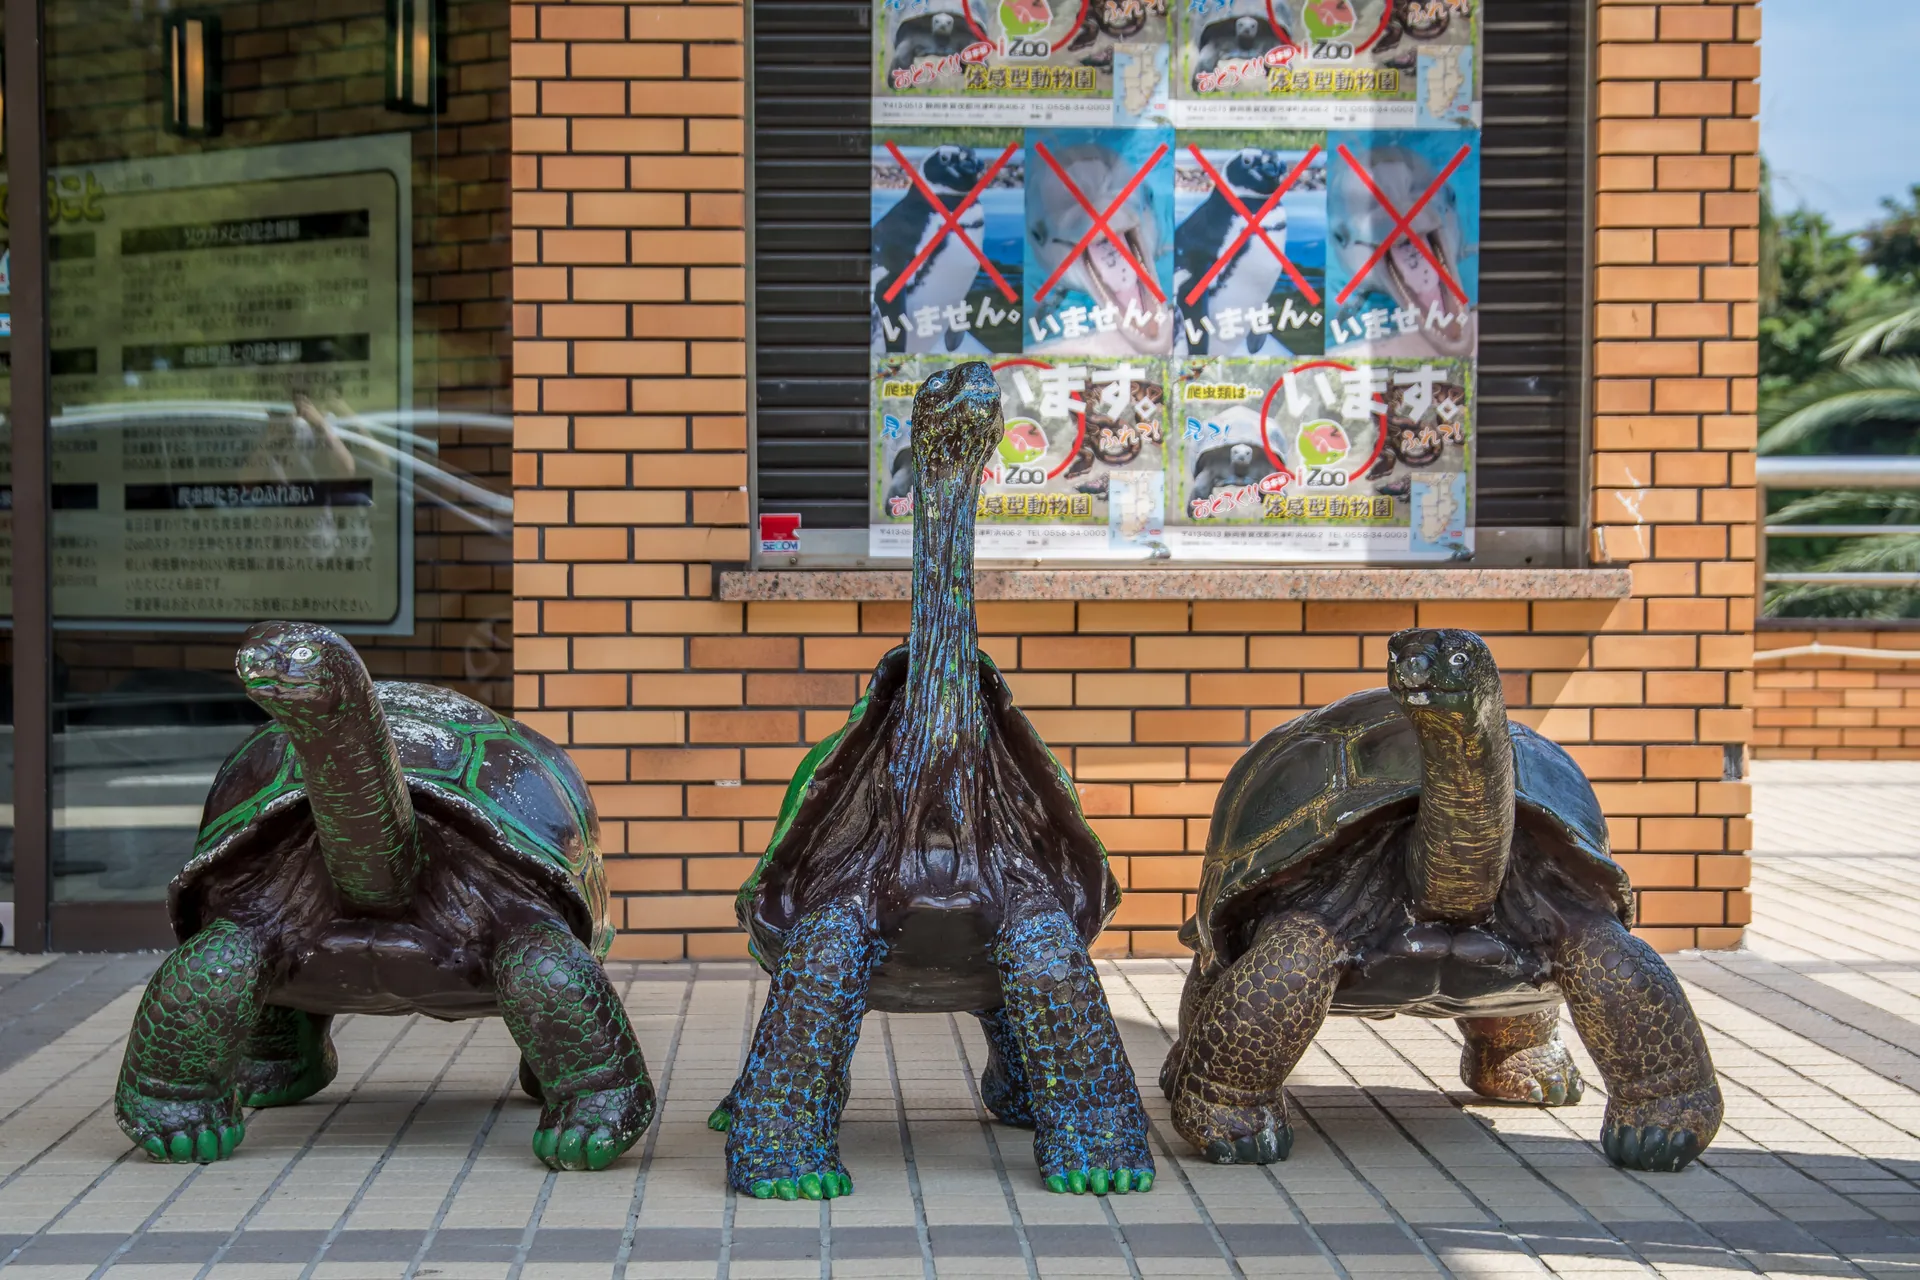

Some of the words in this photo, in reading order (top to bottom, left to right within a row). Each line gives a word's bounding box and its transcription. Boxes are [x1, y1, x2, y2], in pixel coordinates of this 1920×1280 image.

[964, 65, 1096, 90] 体感型動物園
[1268, 68, 1399, 93] 体感型動物園
[883, 296, 1021, 342] いません。
[1029, 298, 1167, 343] いません。
[1184, 298, 1323, 345] いません。
[1330, 300, 1469, 345] いません。
[1283, 364, 1459, 423] います。
[1264, 494, 1394, 518] 体感型動物園
[763, 541, 798, 550] SECOM
